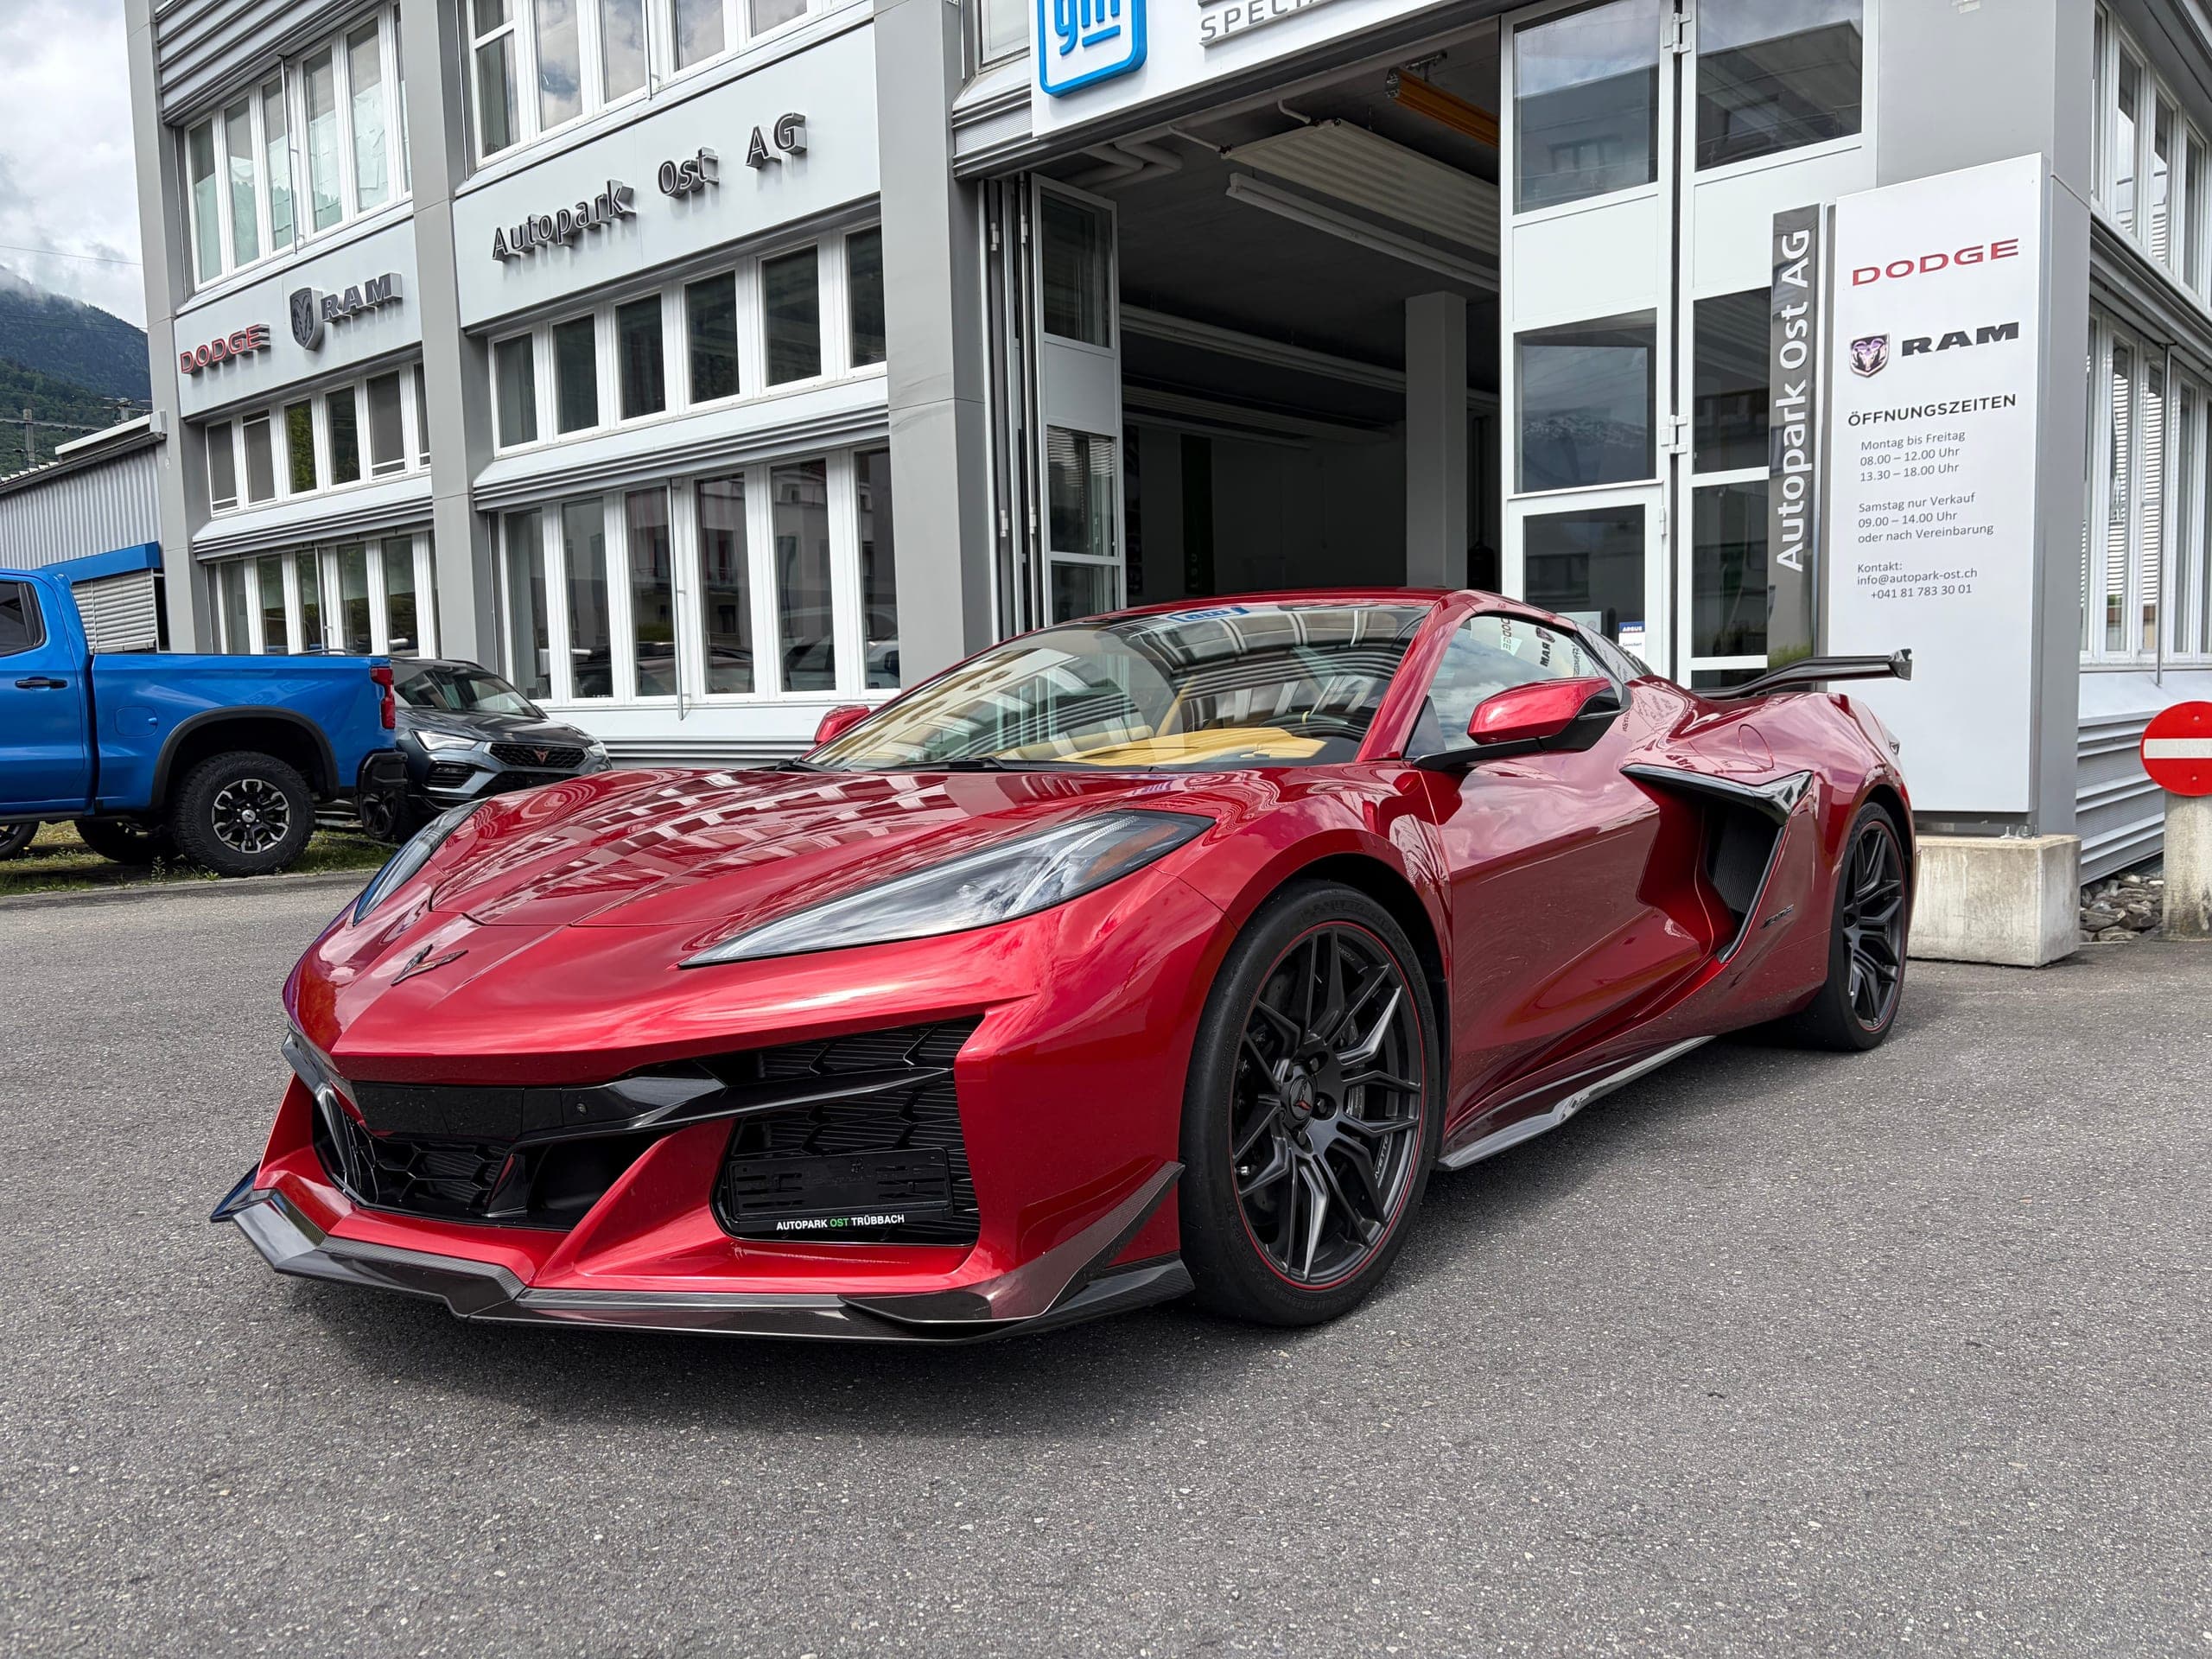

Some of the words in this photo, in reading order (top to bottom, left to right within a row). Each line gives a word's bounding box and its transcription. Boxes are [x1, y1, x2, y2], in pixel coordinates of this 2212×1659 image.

[1201, 0, 1313, 41] SPEC
[493, 179, 635, 261] Autopark
[658, 146, 717, 198] Ost
[746, 112, 806, 168] AG
[1782, 229, 1809, 288] AG
[1853, 238, 2019, 286] DODGE
[320, 273, 399, 322] RAM
[180, 324, 268, 373] DODGE
[1780, 302, 1808, 370] Ost
[1902, 321, 2019, 357] RAM
[1848, 394, 2016, 426] ÖFFNUNGSZEITEN
[1861, 438, 1904, 451] Montag
[1907, 435, 1923, 446] bis
[1926, 431, 1965, 443] Freitag
[1860, 454, 1891, 467] 08.00
[1904, 449, 1936, 461] 12.00
[1939, 447, 1960, 458] Uhr
[1776, 379, 1813, 571] Autopark
[1860, 470, 1891, 481] 13.30
[1904, 465, 1935, 477] 18.00
[1938, 463, 1959, 474] Uhr
[1859, 500, 1904, 512] Samstag
[1908, 499, 1927, 508] nur
[1930, 493, 1975, 506] Verkauf
[1859, 517, 1889, 528] 09.00
[1903, 513, 1933, 524] 14.00
[1936, 512, 1957, 521] Uhr
[1859, 533, 1883, 543] oder
[1886, 530, 1912, 541] nach
[1916, 524, 1994, 539] Vereinbarung
[1858, 562, 1903, 573] Kontakt:
[1858, 568, 1978, 585] info@autopark-ost.ch
[1872, 589, 1897, 600] +041
[1901, 588, 1913, 597] 81
[1918, 587, 1937, 596] 783
[1942, 585, 1955, 594] 30
[1959, 584, 1972, 594] 01
[776, 1217, 827, 1230] AUTOPARK
[830, 1217, 849, 1227] OST
[851, 1213, 905, 1226] TRÜBBACH
